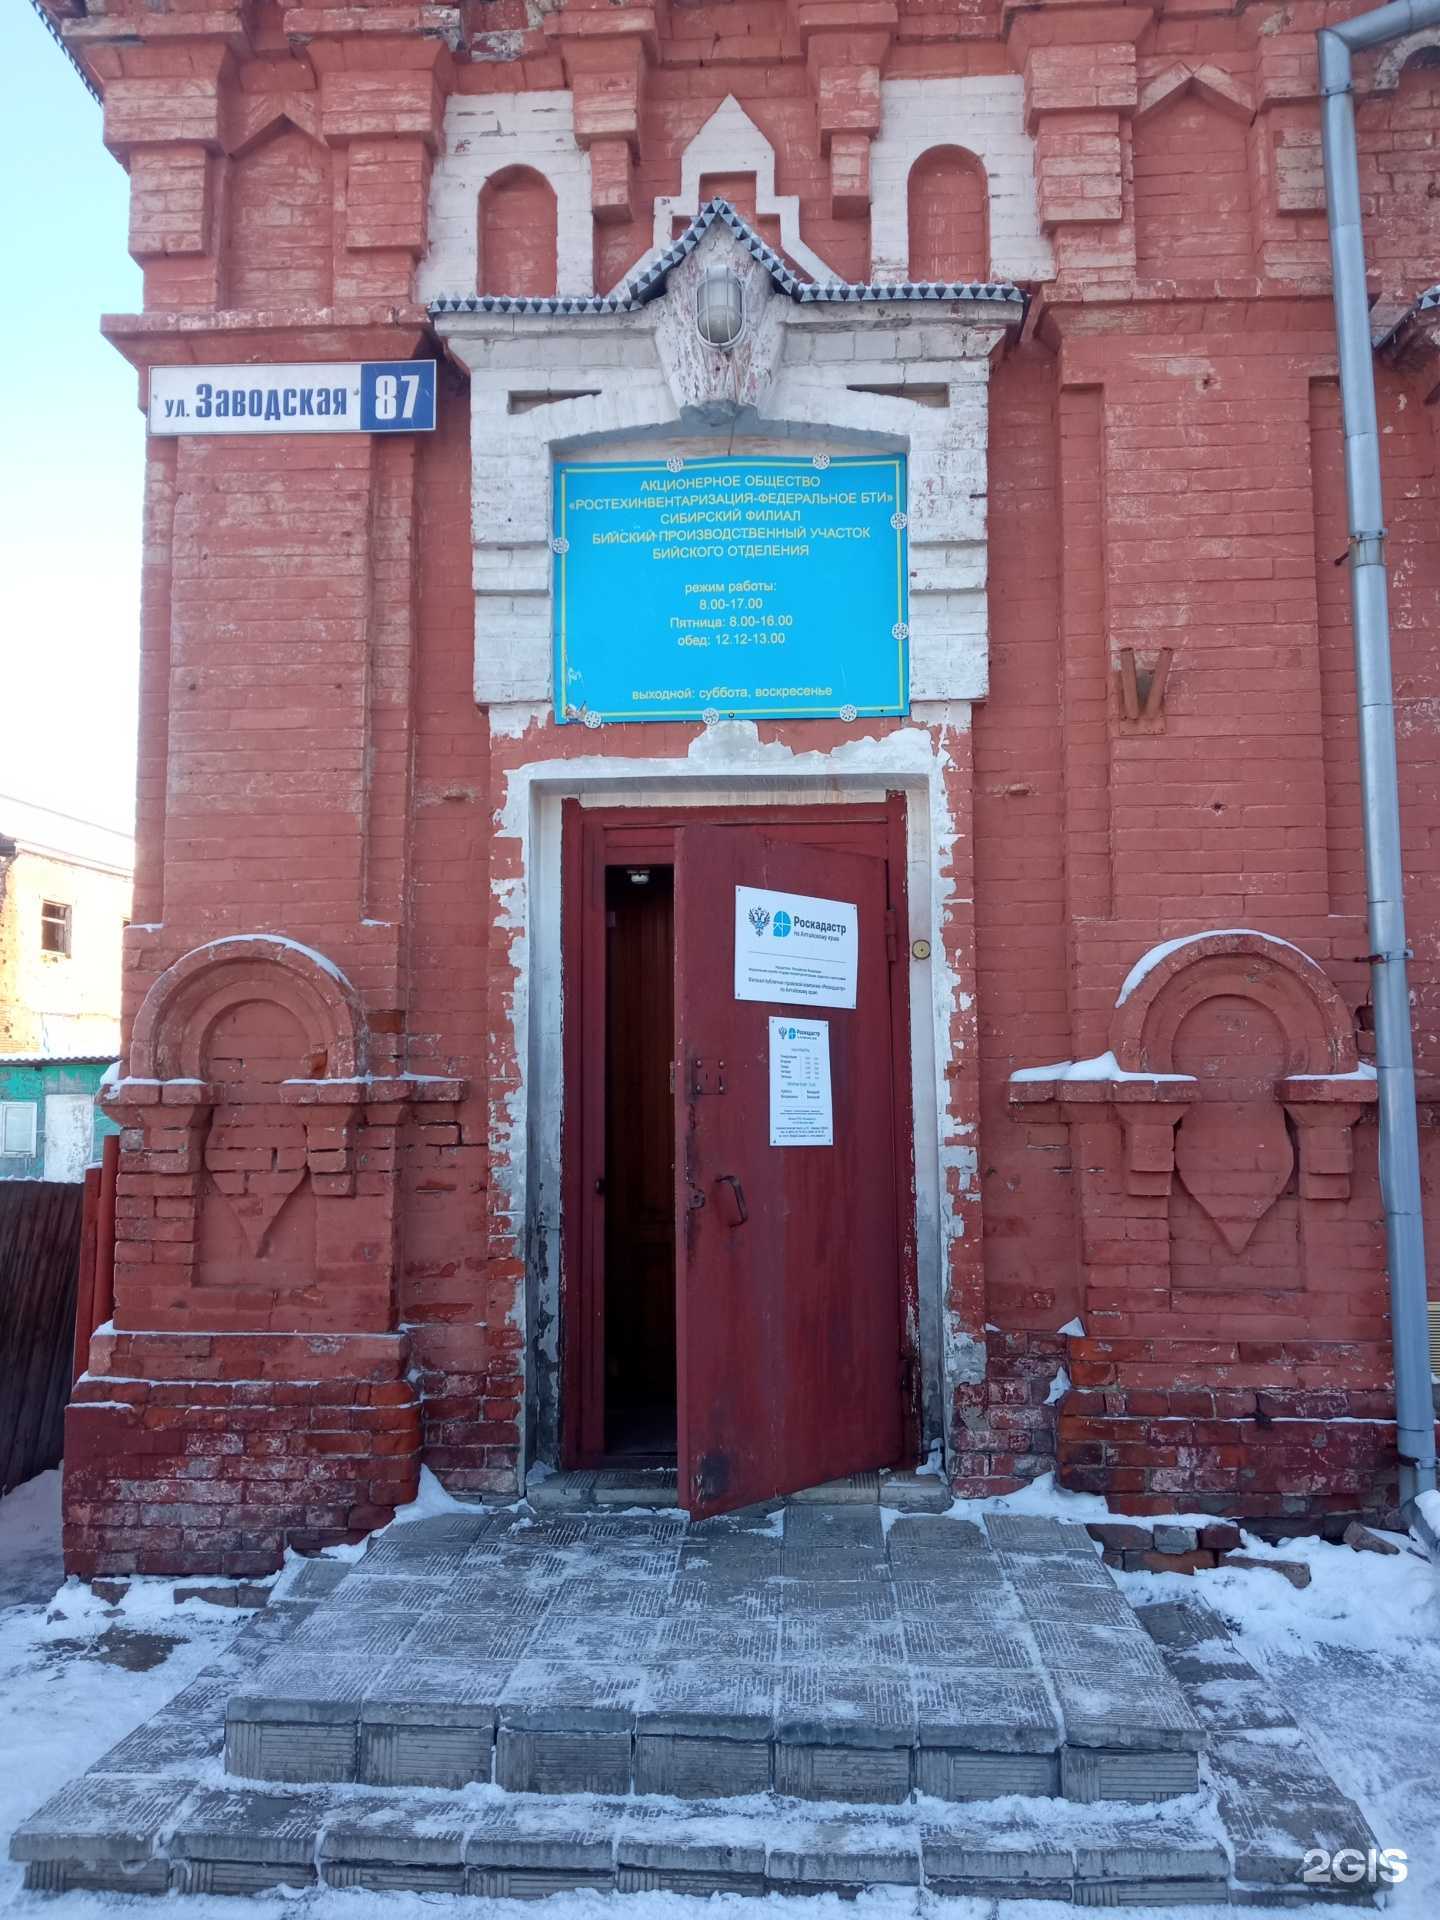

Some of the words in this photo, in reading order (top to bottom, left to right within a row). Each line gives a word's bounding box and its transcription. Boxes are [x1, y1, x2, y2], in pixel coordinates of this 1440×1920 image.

[164, 398, 190, 418] ул.
[195, 383, 347, 421] Заводская
[375, 375, 420, 420] 87
[640, 475, 741, 493] АКЦИОНЕРНОЕ
[744, 475, 821, 488] ОБЩЕСТВО
[569, 492, 857, 510] «РОСТЕХИНВЕНТАРИЗАЦИЯ-ФЕДЕРАЛЬНОЕ
[860, 492, 893, 504] БТИ»
[660, 508, 742, 525] СИБИРСКИЙ
[745, 510, 801, 521] ФИЛИАЛ
[592, 530, 656, 545] БИЙСКИЙ
[659, 526, 806, 541] ПРОИЗВОДСТВЕННЫЙ
[810, 527, 871, 539] УЧАСТОК
[653, 544, 724, 560] БИЙСКОГО
[727, 544, 810, 559] ОТДЕЛЕНИЯ
[684, 582, 725, 595] режим
[728, 580, 777, 594] работы:
[699, 598, 763, 610] 8.00-17.00
[670, 616, 726, 629] Пятница:
[729, 615, 793, 627] 8.00-16.00
[677, 634, 711, 647] обед:
[715, 632, 786, 645] 12.12-13.00
[632, 688, 695, 701] выходной:
[699, 687, 751, 700] суббота,
[755, 686, 833, 698] воскресенье
[793, 915, 847, 936] Роскадастр
